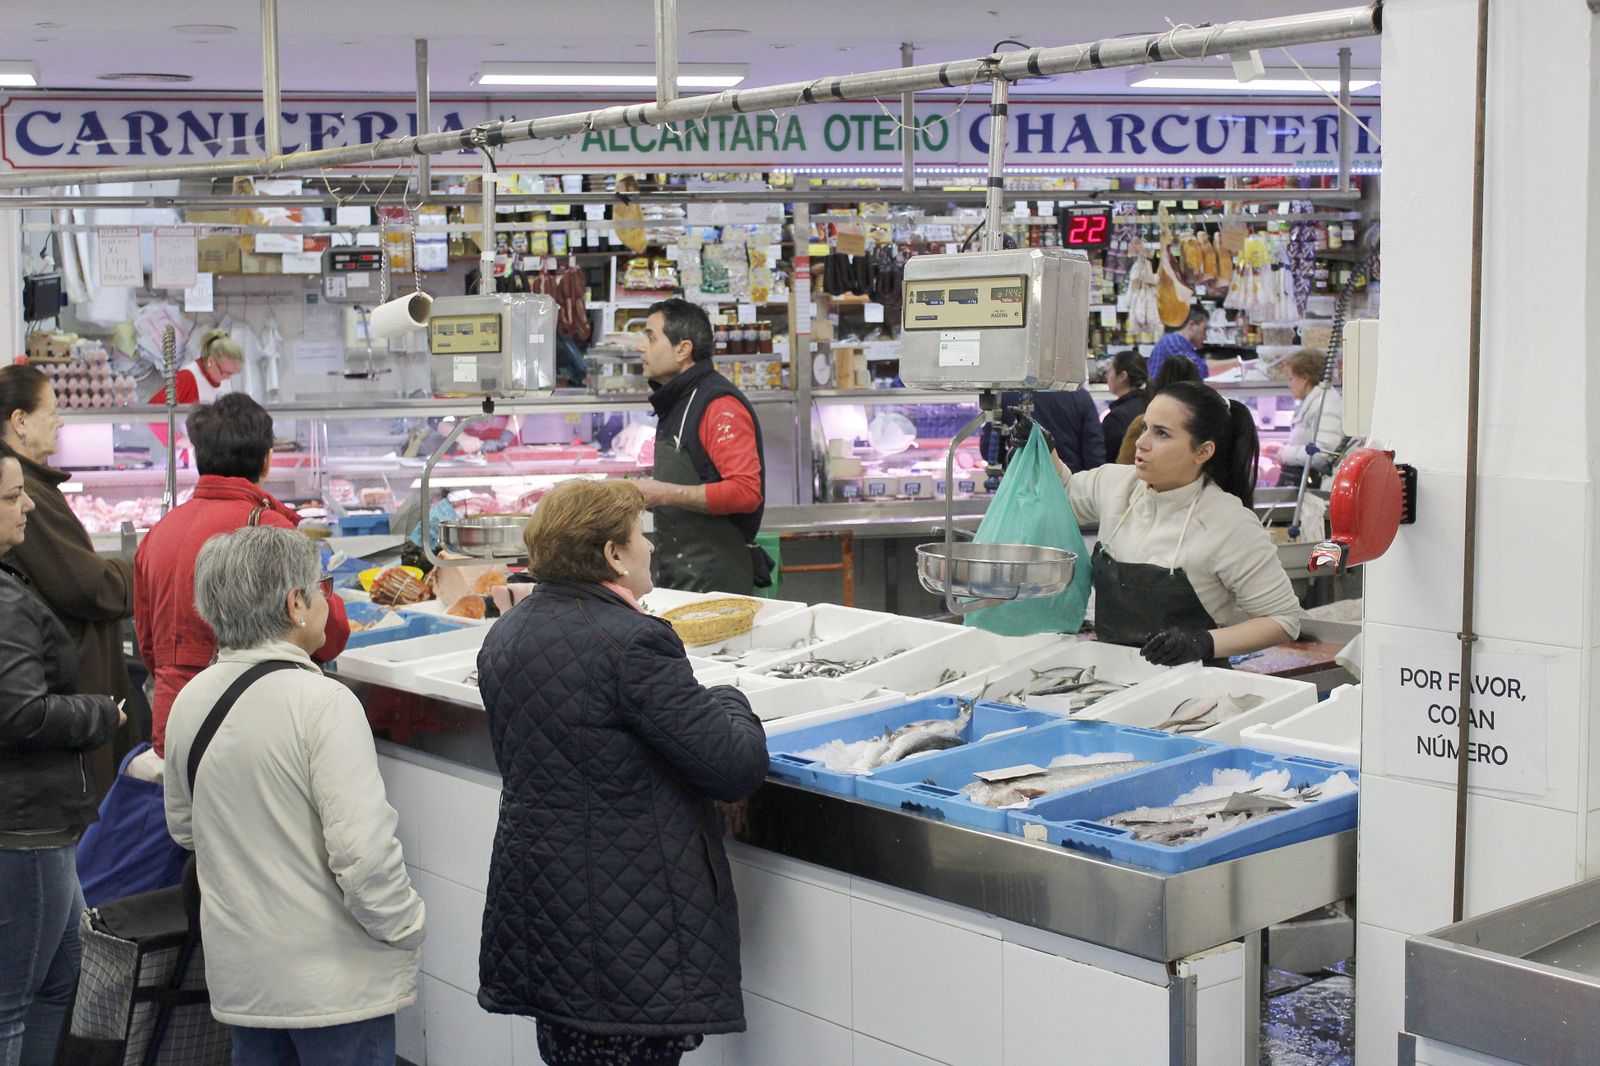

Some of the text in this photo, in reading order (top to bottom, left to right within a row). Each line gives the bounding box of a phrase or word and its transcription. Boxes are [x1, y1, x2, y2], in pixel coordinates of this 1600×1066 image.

[824, 113, 949, 152] OTERO
[969, 112, 1382, 155] CHARCUTERI
[1069, 216, 1107, 244] 22
[1400, 667, 1442, 690] POR
[1428, 704, 1495, 730] COAN
[1417, 734, 1508, 766] NÚMERO
